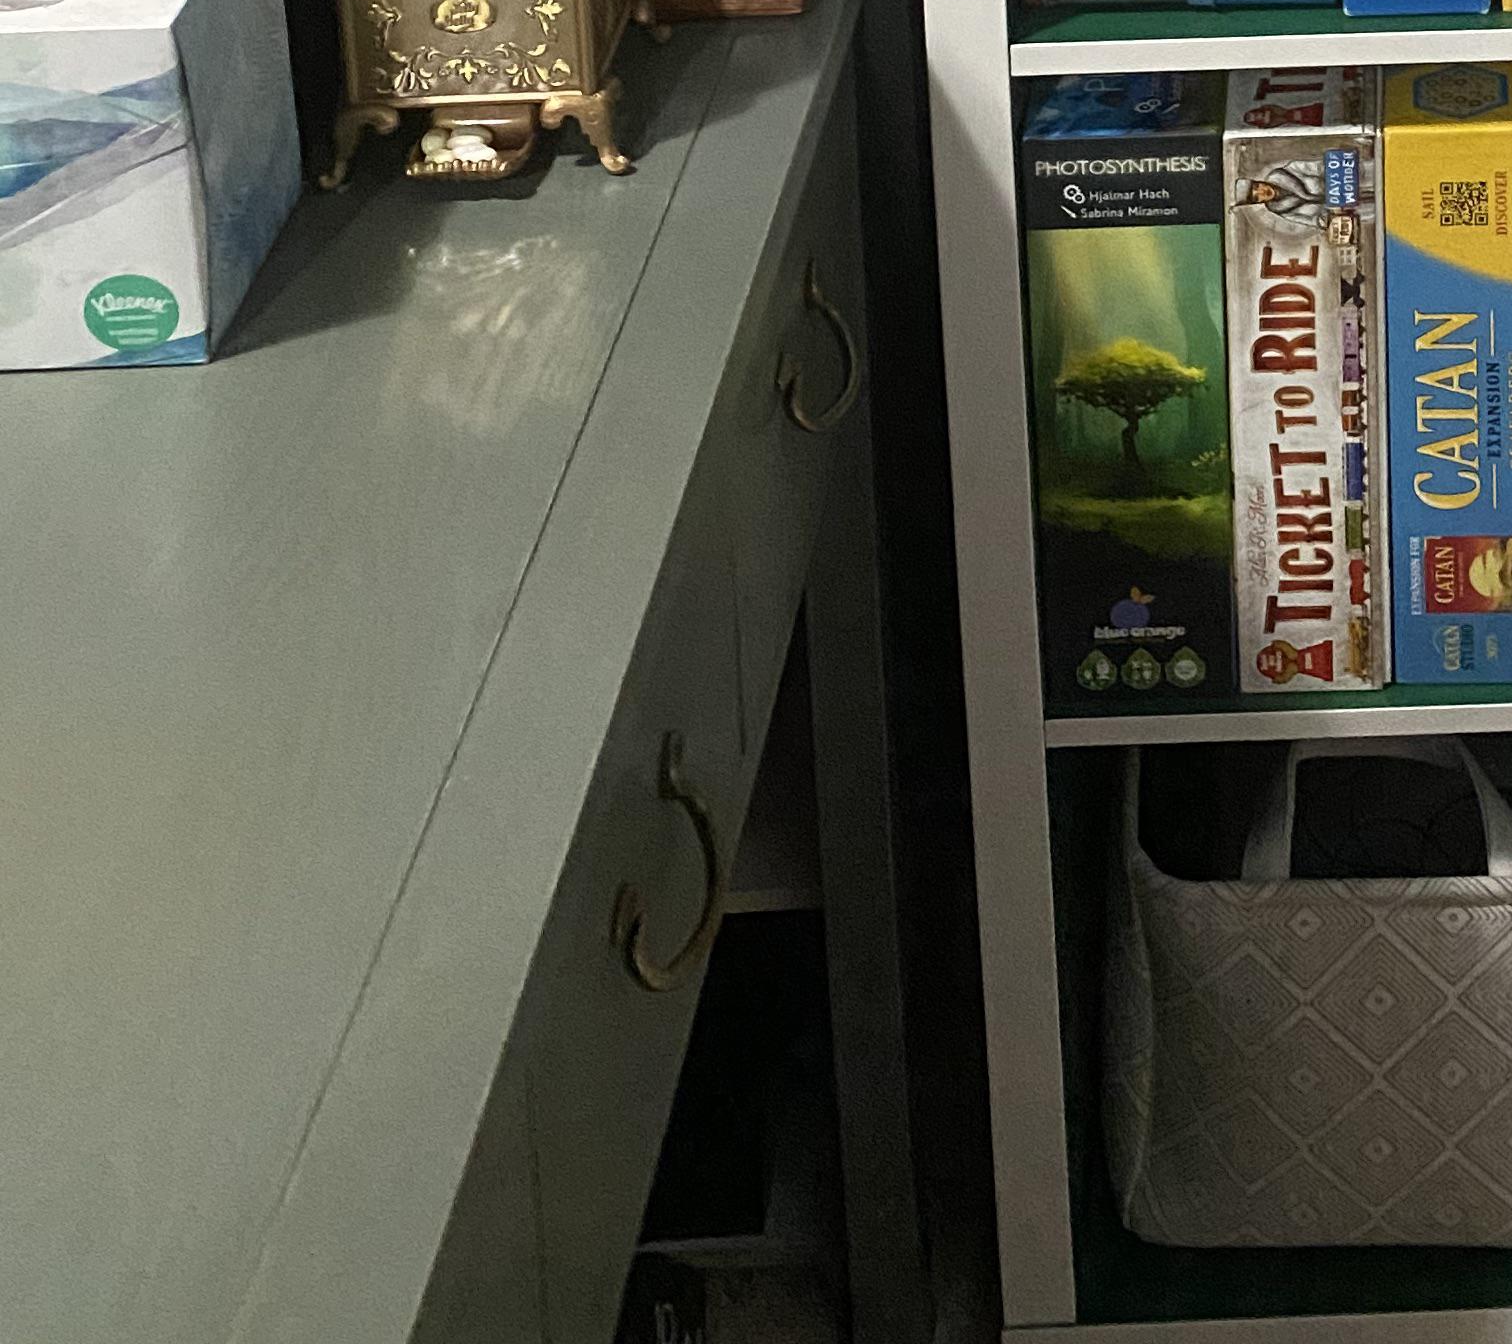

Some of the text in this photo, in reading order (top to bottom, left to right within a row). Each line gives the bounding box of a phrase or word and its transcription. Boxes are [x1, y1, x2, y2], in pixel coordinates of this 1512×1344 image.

[1035, 156, 1206, 177] PHOTOSYNTHESIS
[1327, 151, 1341, 204] DAYS OF
[1343, 152, 1356, 204] WONDER
[1080, 206, 1179, 219] Sabrina Miramon
[1089, 188, 1170, 204] Hjalmar Hach
[1423, 188, 1436, 219] SAIL
[1495, 169, 1509, 237] DISCOVER
[90, 293, 174, 317] Kleenex
[1413, 308, 1483, 512] CATAN
[1488, 360, 1501, 459] EXPANSION
[1250, 243, 1334, 636] TICKET TO RIDE
[1433, 544, 1455, 604] CATAN
[1094, 626, 1186, 640] blue orange
